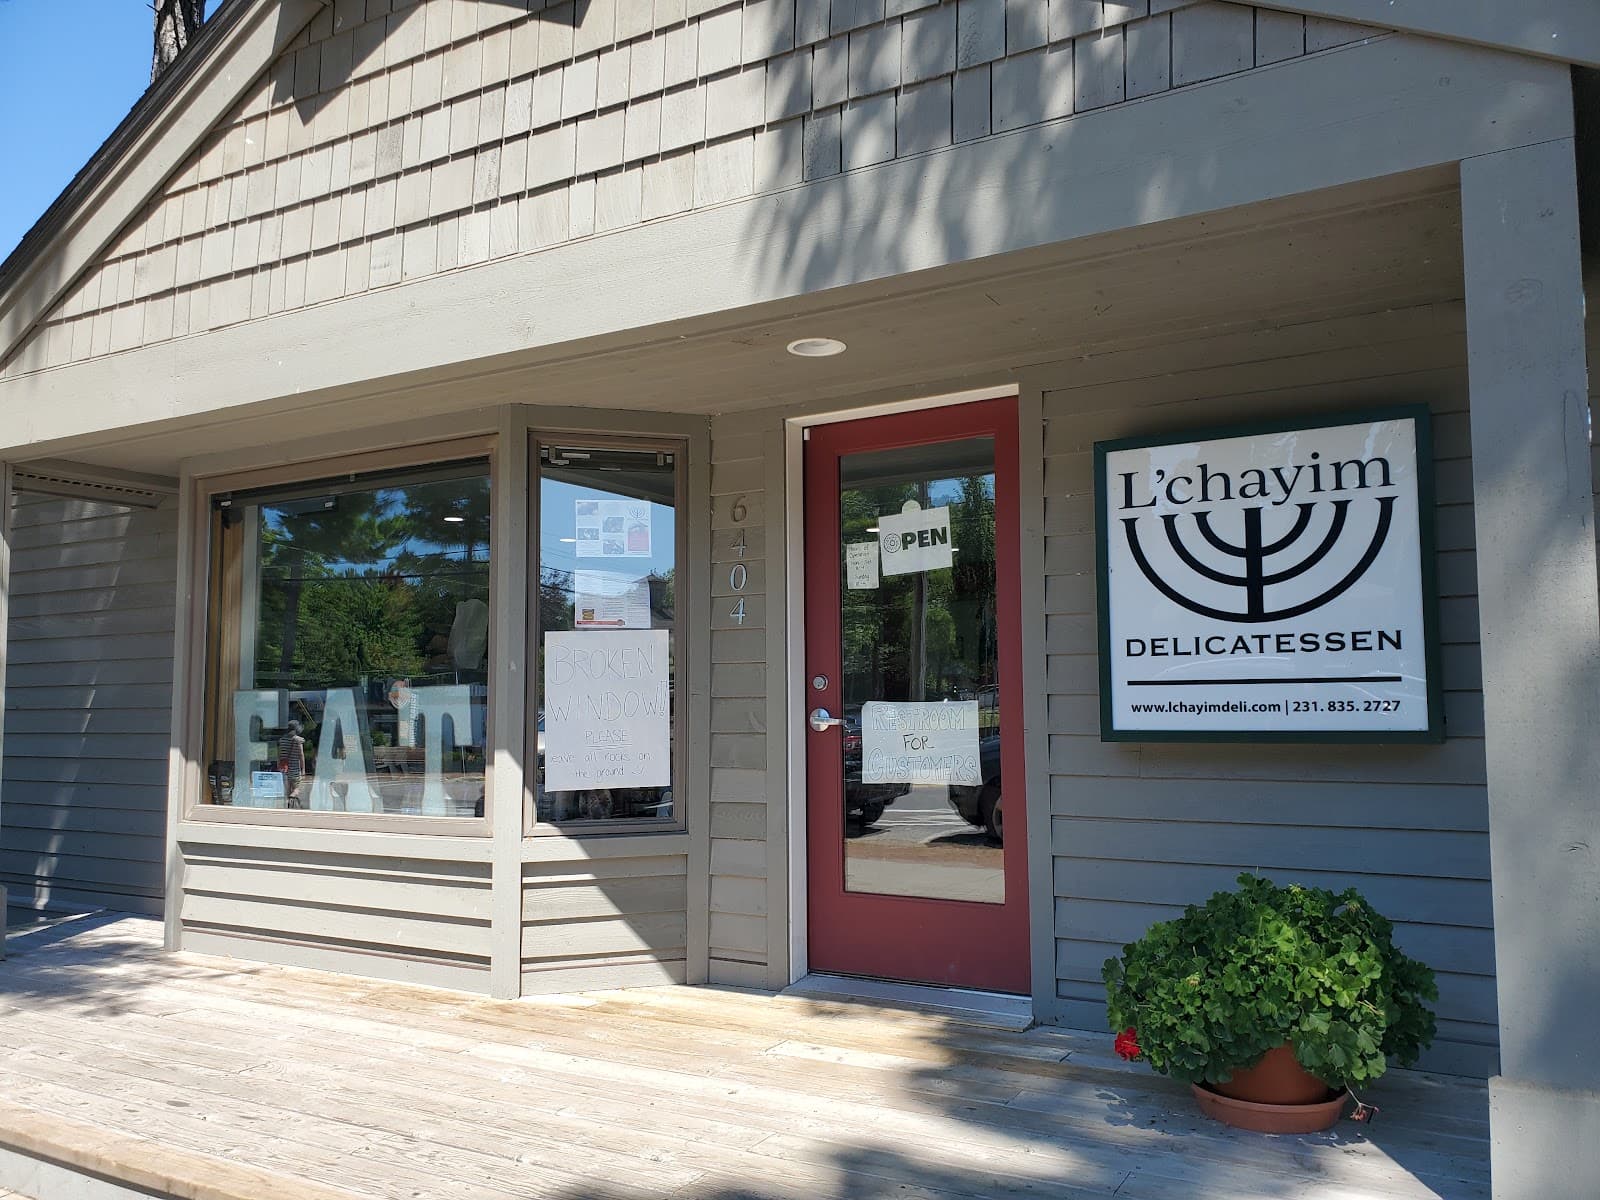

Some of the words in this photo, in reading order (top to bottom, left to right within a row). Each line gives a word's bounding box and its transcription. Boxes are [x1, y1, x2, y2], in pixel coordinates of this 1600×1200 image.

[1126, 630, 1402, 657] DELICATESSEN
[551, 644, 653, 685] BROKEN
[1131, 701, 1281, 716] www.lchayimdeli.com
[584, 729, 631, 744] PLEASE
[903, 733, 935, 751] FOR
[232, 684, 474, 817] EAT
[584, 752, 597, 762] all
[604, 752, 631, 762] rocks
[867, 748, 979, 782] CUSTOMERS
